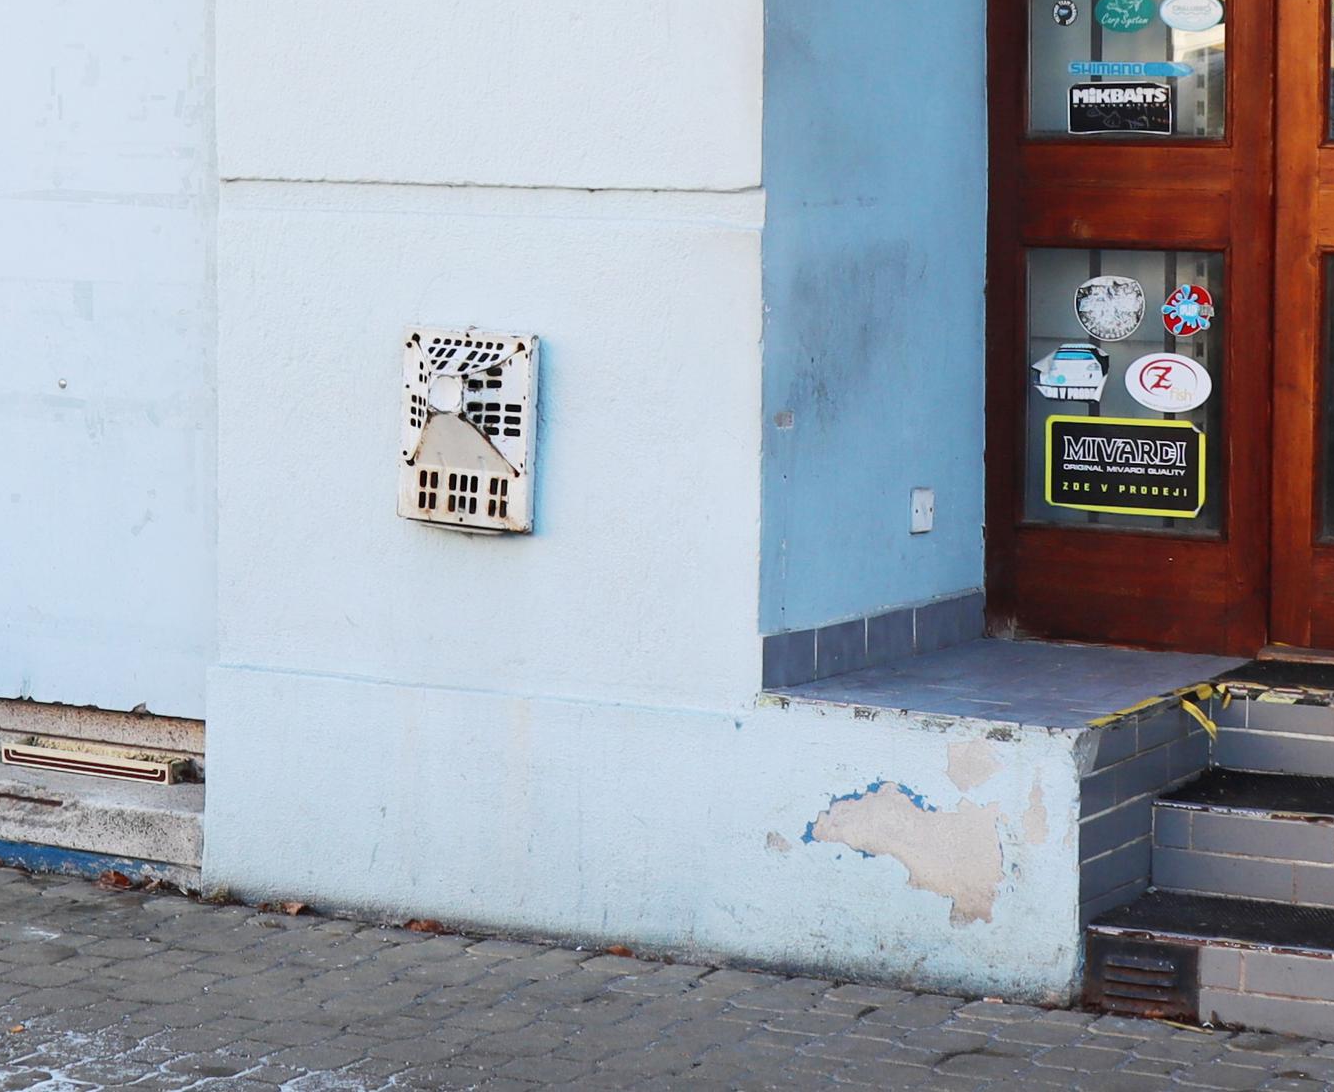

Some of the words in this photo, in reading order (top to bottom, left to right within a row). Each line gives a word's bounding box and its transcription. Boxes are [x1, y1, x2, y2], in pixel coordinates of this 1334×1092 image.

[1101, 13, 1120, 27] Carp
[1121, 13, 1149, 27] System
[1070, 63, 1144, 75] SHIMANO
[1063, 436, 1188, 467] MIVARDI
[1063, 463, 1104, 472] ORIGINAL
[1106, 466, 1146, 475] MIVARDI
[1147, 467, 1186, 477] QUALITY
[1062, 481, 1090, 492] ZDE
[1100, 483, 1108, 493] V
[1119, 484, 1188, 497] PRODEJI
